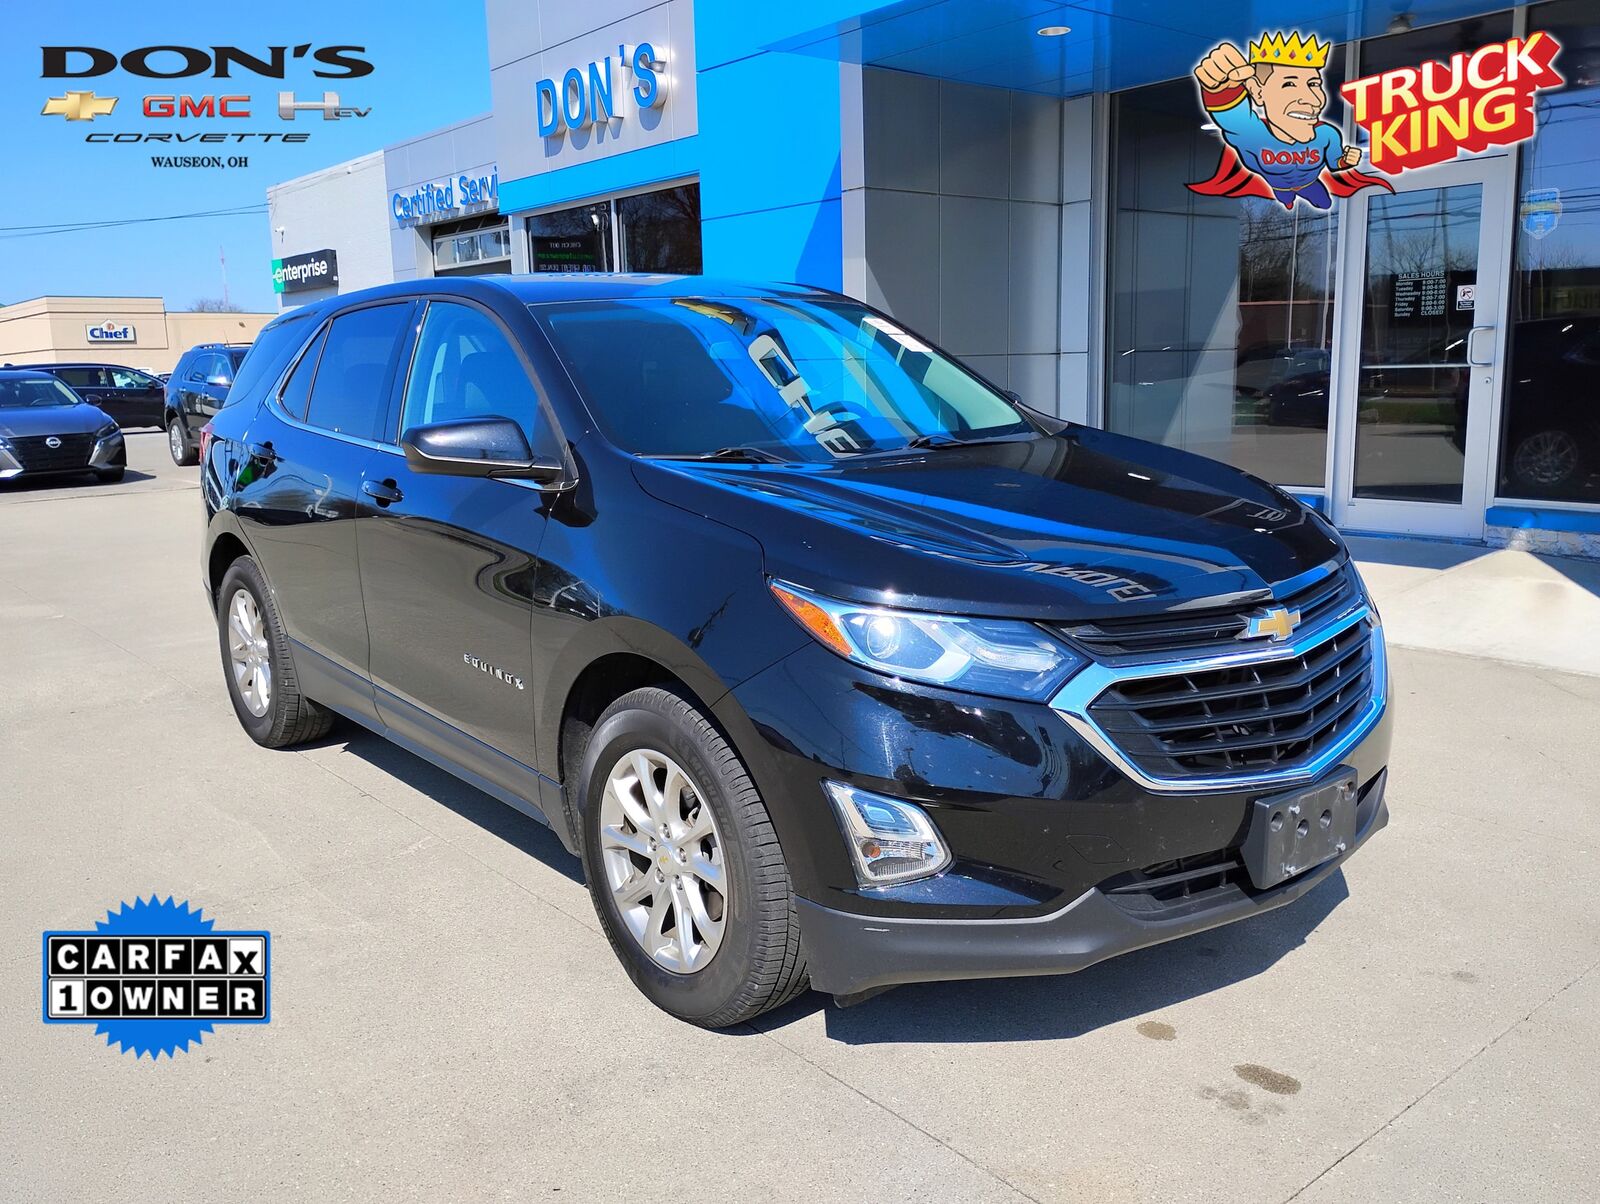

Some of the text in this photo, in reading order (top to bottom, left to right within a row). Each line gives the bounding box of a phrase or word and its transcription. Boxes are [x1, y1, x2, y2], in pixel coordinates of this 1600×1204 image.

[535, 42, 662, 138] DON'S
[393, 177, 455, 220] Certified
[273, 257, 328, 284] enterprise
[1398, 272, 1420, 280] SALES
[89, 327, 129, 339] Chief
[463, 653, 524, 690] EQUINOX
